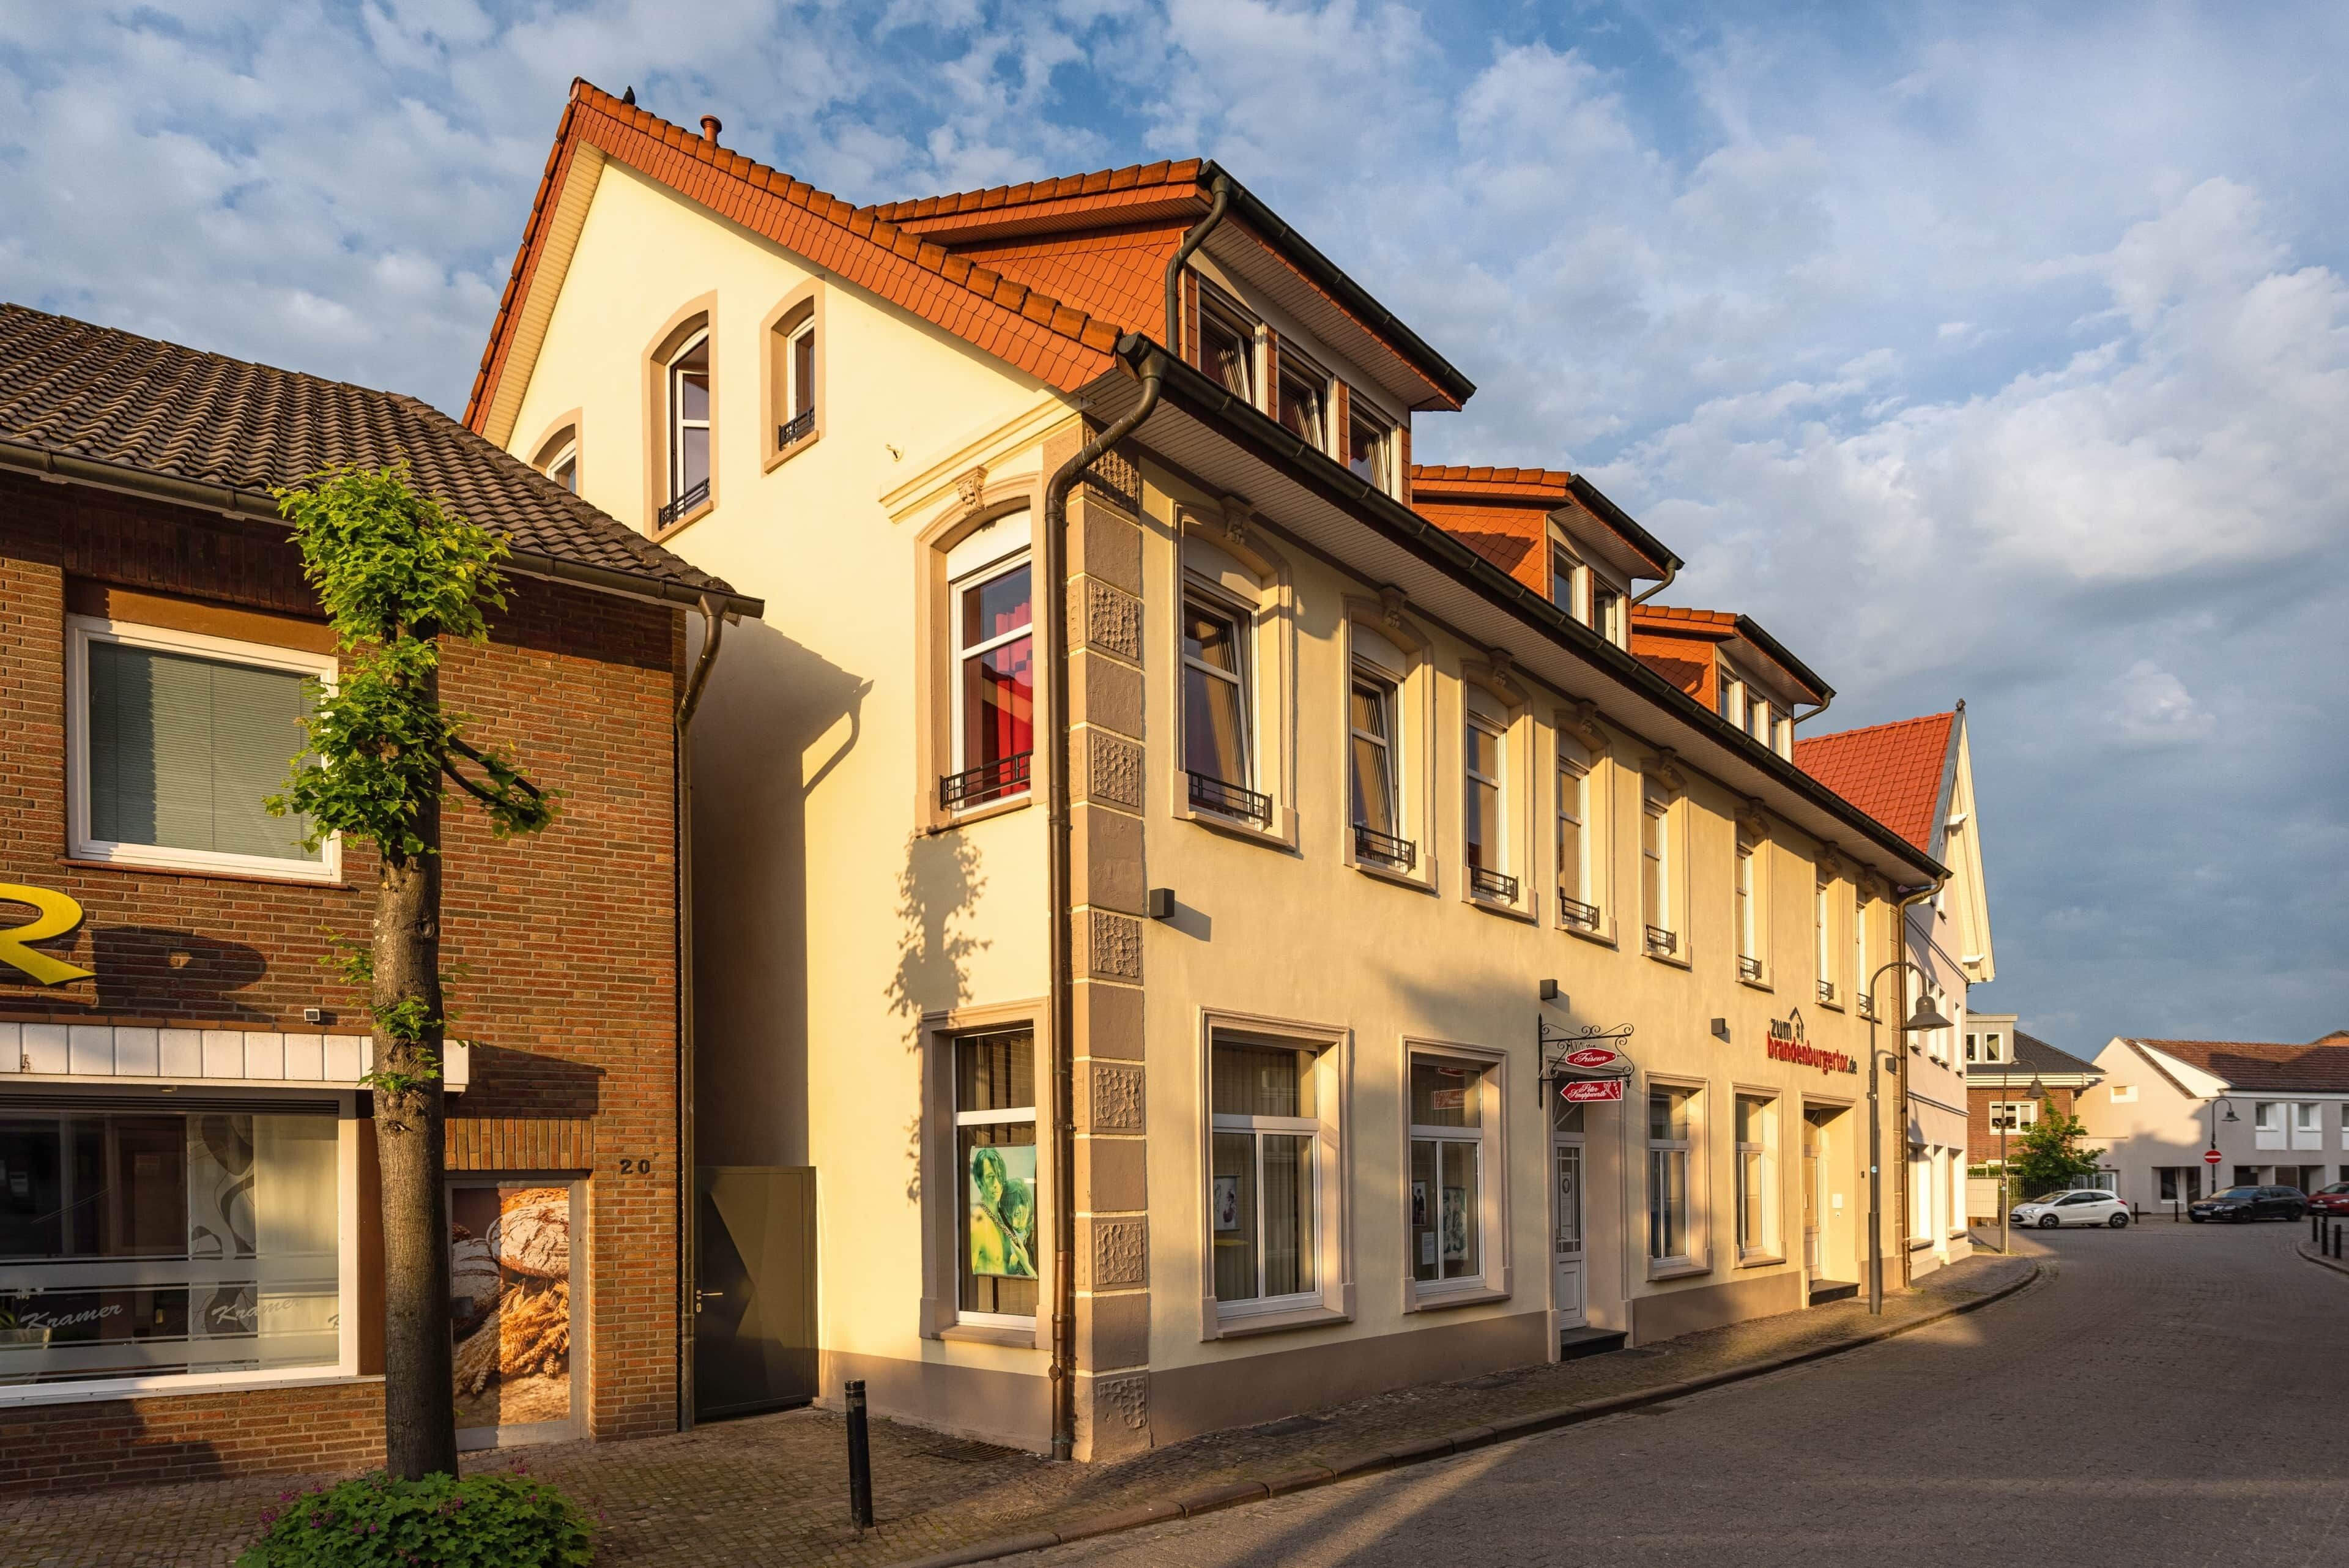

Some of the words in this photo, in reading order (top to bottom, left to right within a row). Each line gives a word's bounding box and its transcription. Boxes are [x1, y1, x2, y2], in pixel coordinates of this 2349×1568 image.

[1770, 1018, 1792, 1041] zum
[1574, 1052, 1608, 1063] Friseur
[1767, 1030, 1857, 1076] brandenburgertor.de
[1579, 1083, 1599, 1093] Peter
[620, 1159, 650, 1175] 20
[20, 1304, 122, 1330] Kramer
